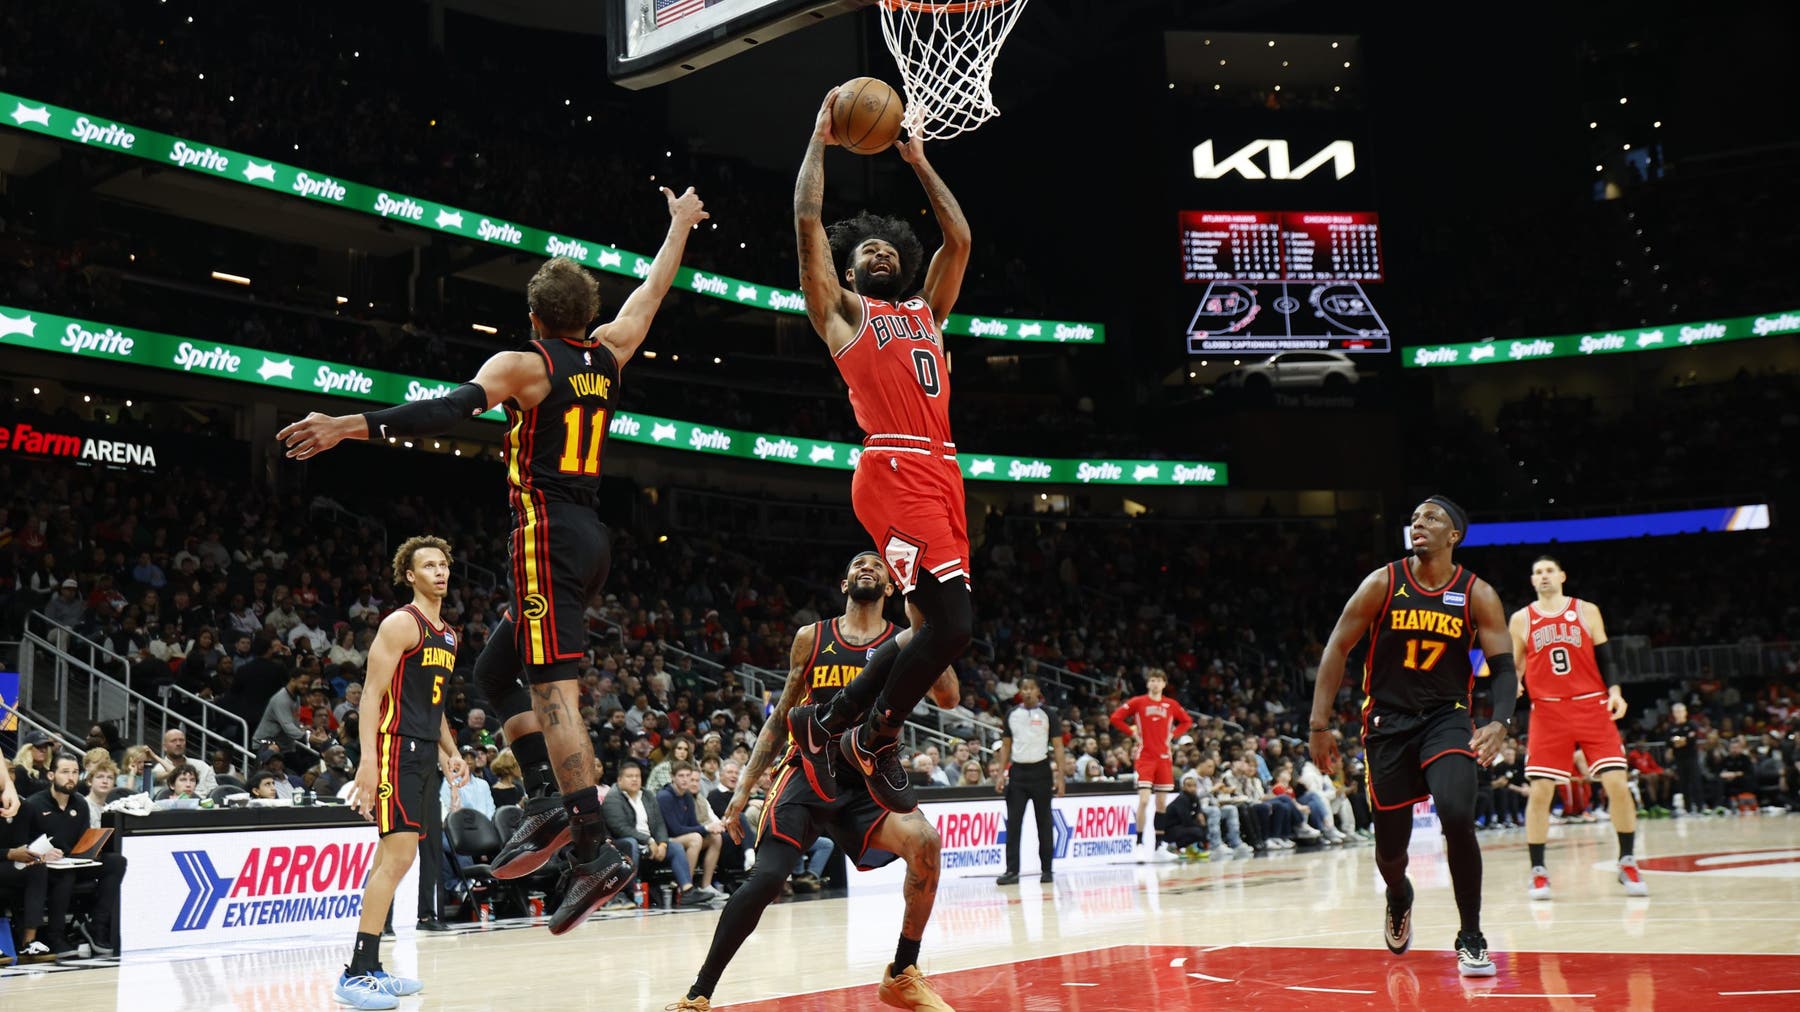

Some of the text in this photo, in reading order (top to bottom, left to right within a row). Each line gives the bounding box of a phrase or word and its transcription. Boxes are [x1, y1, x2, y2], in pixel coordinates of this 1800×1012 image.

[71, 116, 136, 149] Sprite
[169, 141, 229, 172] Sprite
[293, 171, 346, 201] Sprite
[374, 192, 424, 221] Sprite
[477, 218, 523, 245] Sprite
[545, 235, 588, 260] Sprite
[691, 272, 729, 296] Sprite
[968, 318, 1009, 337] Sprite
[1053, 323, 1095, 342] Sprite
[869, 314, 943, 351] BULL
[1232, 340, 1277, 349] CAPTIONING
[1278, 340, 1318, 349] PRESENTED
[1414, 346, 1459, 367] Sprite
[1508, 339, 1555, 360] Sprite
[1578, 333, 1626, 355] Sprite
[1677, 323, 1727, 345] Sprite
[568, 372, 612, 400] YOUNG
[911, 348, 941, 398] 0
[60, 323, 135, 356] Sprite
[173, 341, 241, 373] Sprite
[313, 365, 373, 394] Sprite
[689, 427, 732, 451] Sprite
[753, 436, 799, 460] Sprite
[1007, 459, 1052, 481] Sprite
[1076, 461, 1123, 483] Sprite
[1171, 463, 1216, 485] Sprite
[11, 423, 82, 458] Farm
[82, 438, 157, 467] ARENA
[559, 404, 607, 475] 11
[1391, 609, 1464, 638] HAWKS
[1532, 623, 1582, 654] BULLS
[1403, 638, 1448, 672] 17
[1549, 647, 1572, 676] 9
[431, 674, 446, 706] 5
[812, 664, 866, 689] HAW
[936, 811, 1001, 849] ARROW
[1074, 805, 1132, 839] ARROW
[942, 849, 1002, 870] TERMINATORS
[1072, 838, 1134, 858] EXTERMINATORS
[229, 842, 376, 898] ARROW
